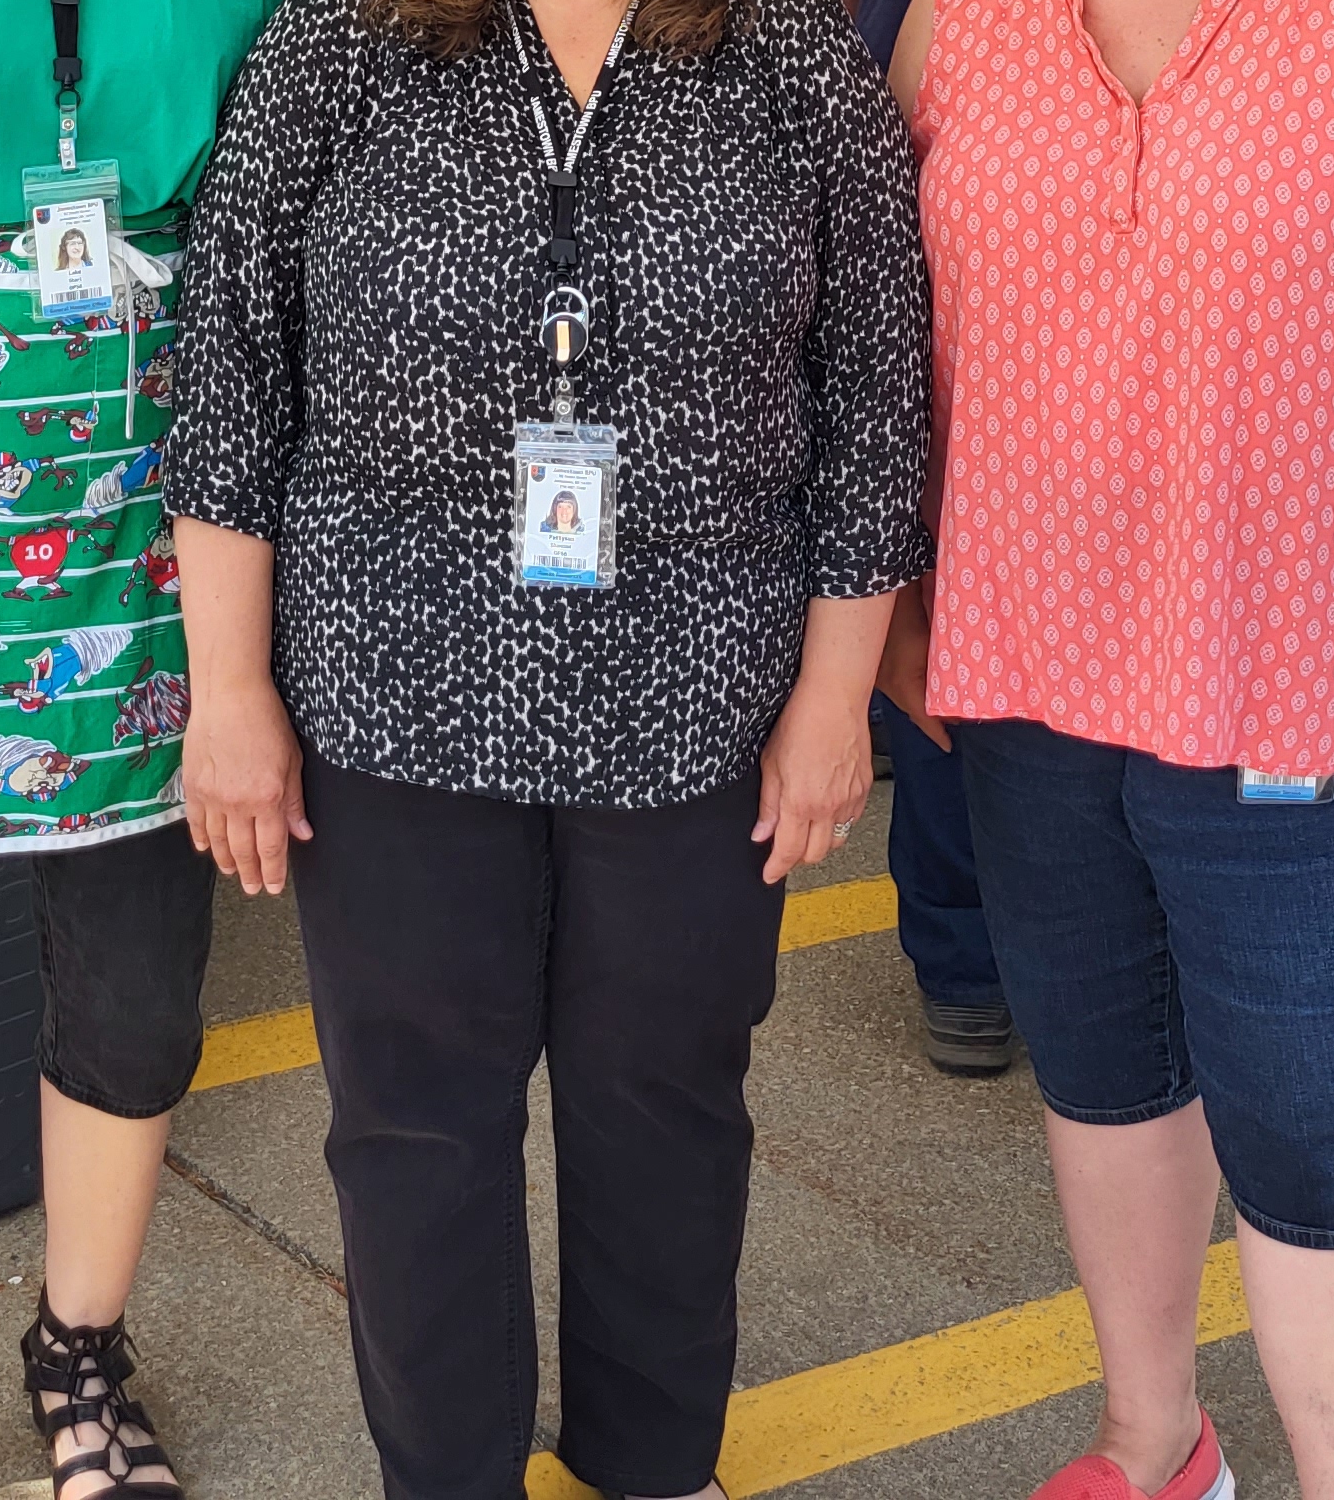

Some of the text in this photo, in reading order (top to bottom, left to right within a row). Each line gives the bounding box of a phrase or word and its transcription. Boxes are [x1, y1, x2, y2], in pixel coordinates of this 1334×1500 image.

[518, 49, 529, 73] BPU
[530, 96, 558, 173] JAMESTOWN BP
[563, 90, 602, 173] JAMESTOWN BPU
[24, 543, 53, 561] 10
